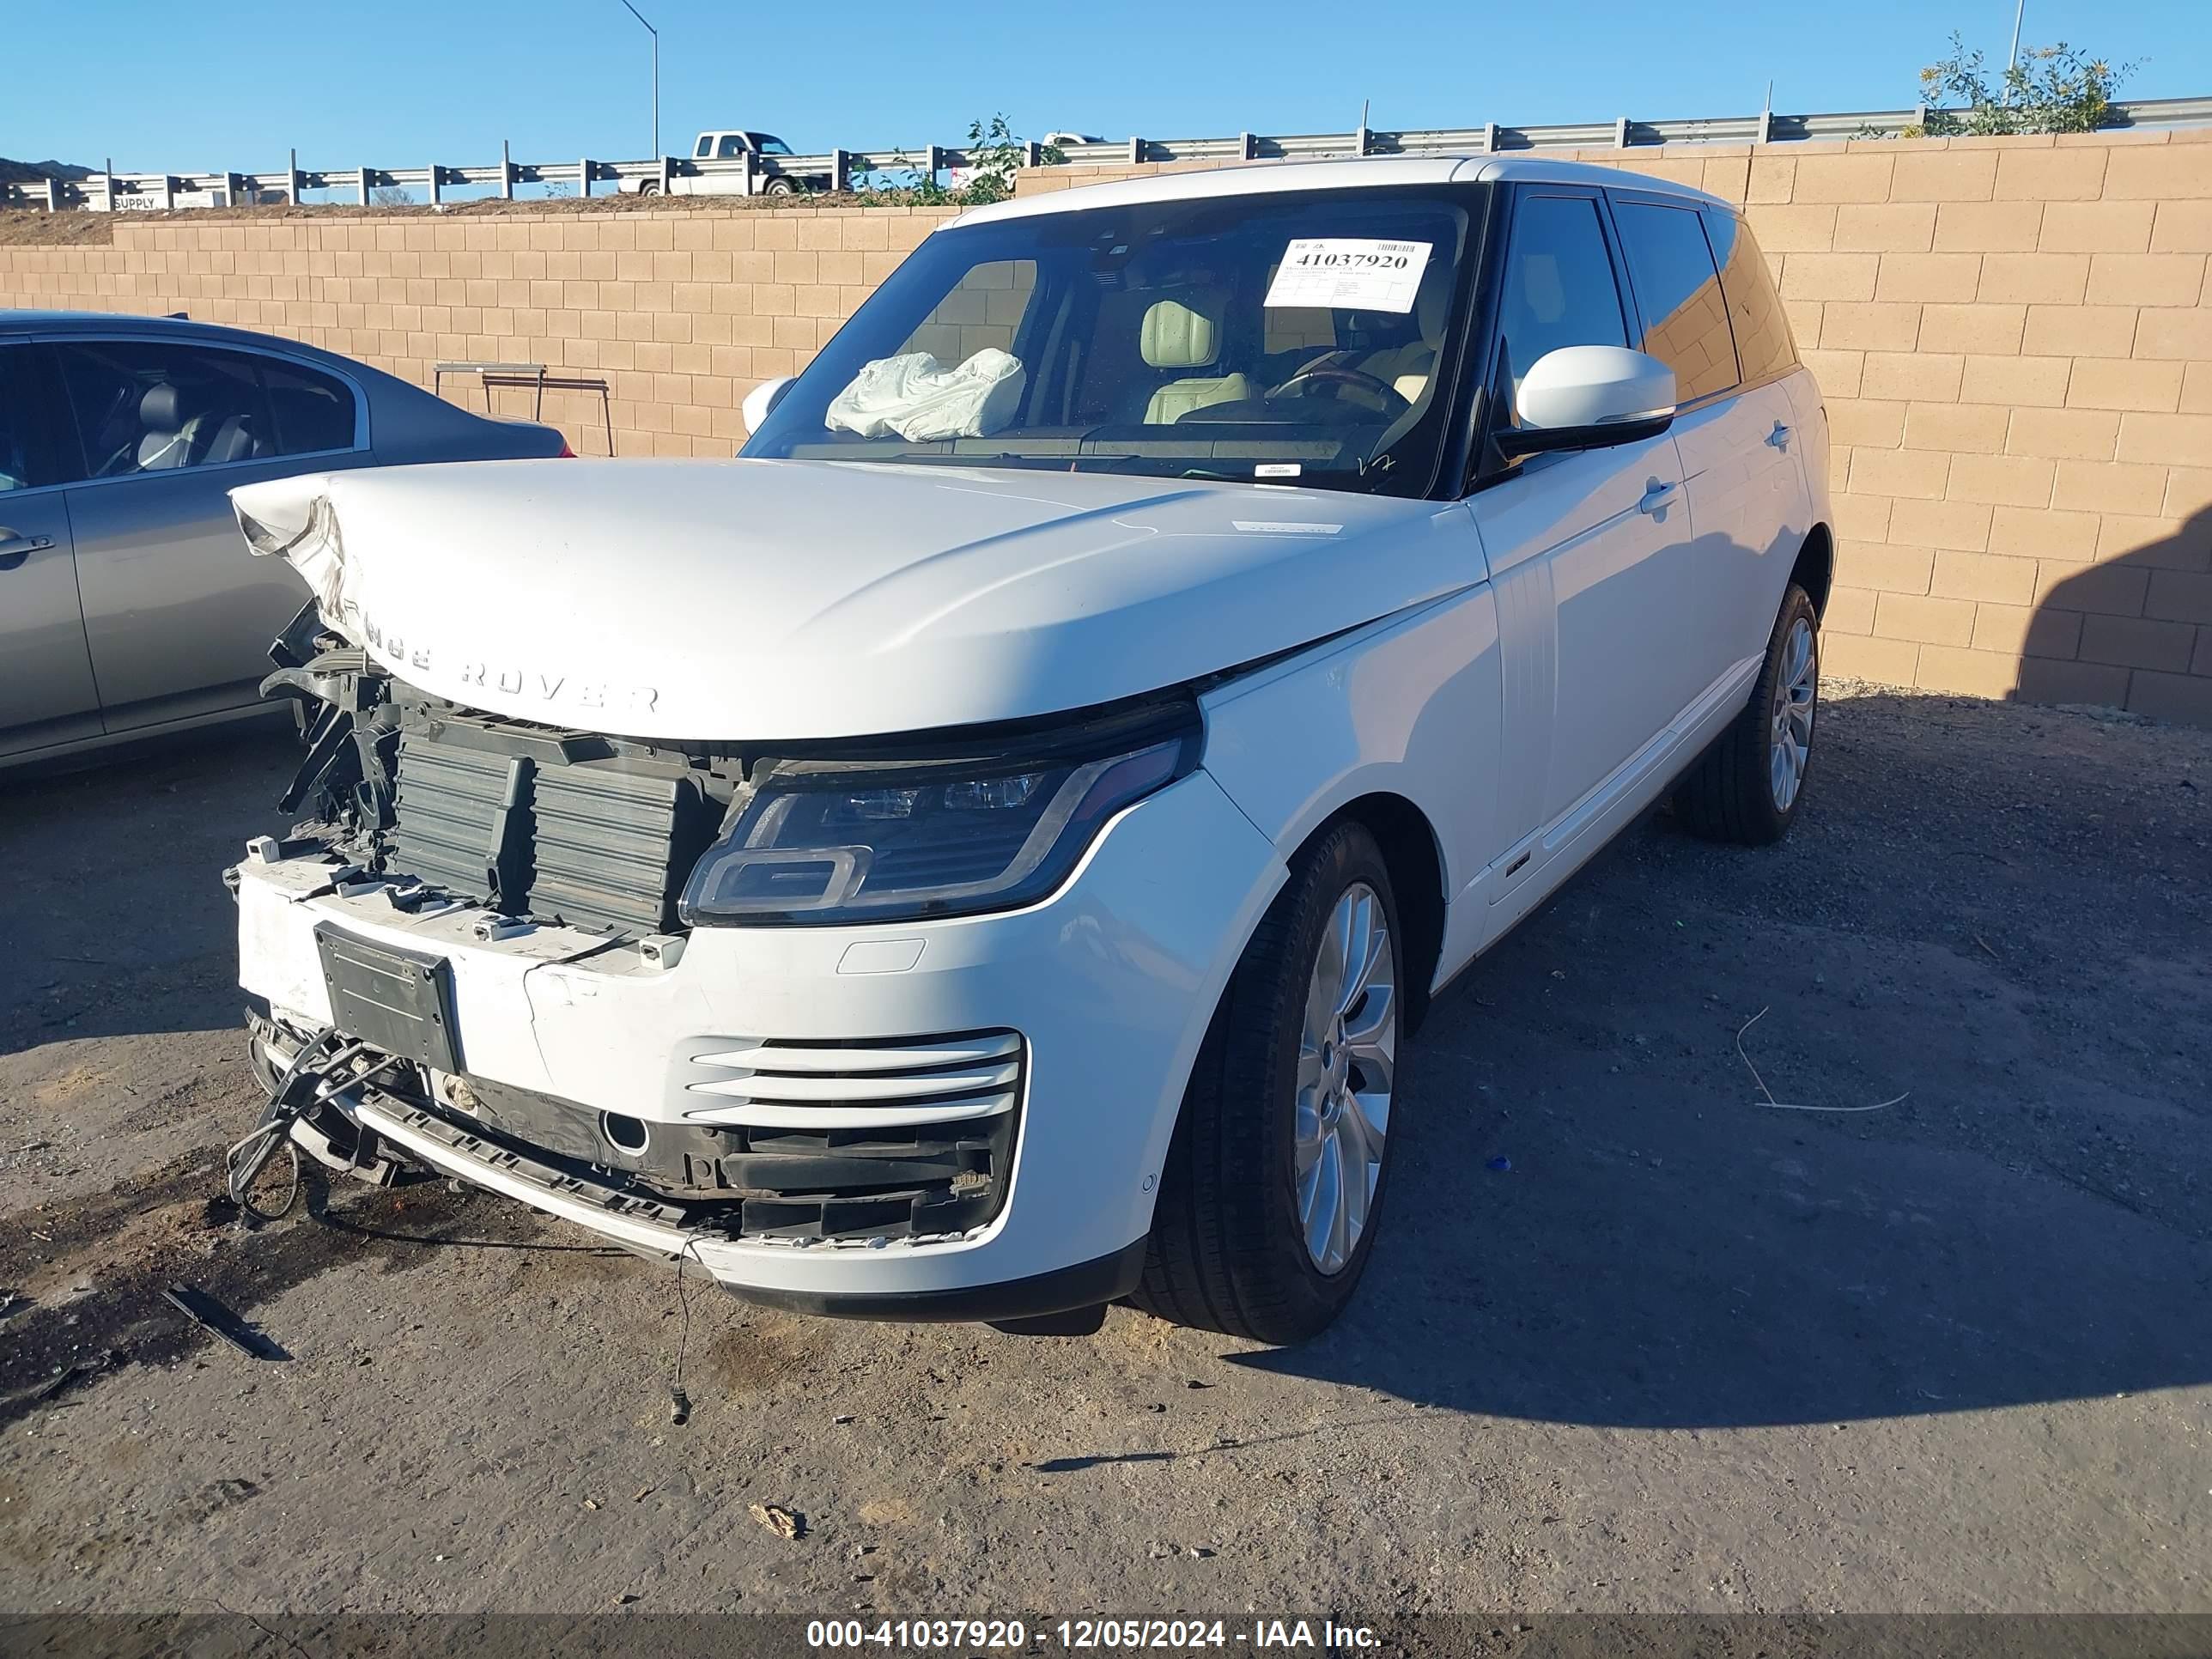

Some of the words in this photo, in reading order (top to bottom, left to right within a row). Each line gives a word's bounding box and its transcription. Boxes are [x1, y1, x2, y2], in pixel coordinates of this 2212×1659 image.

[114, 198, 155, 209] SUPPLY
[1296, 253, 1408, 269] 41037920
[461, 661, 660, 714] ROVER
